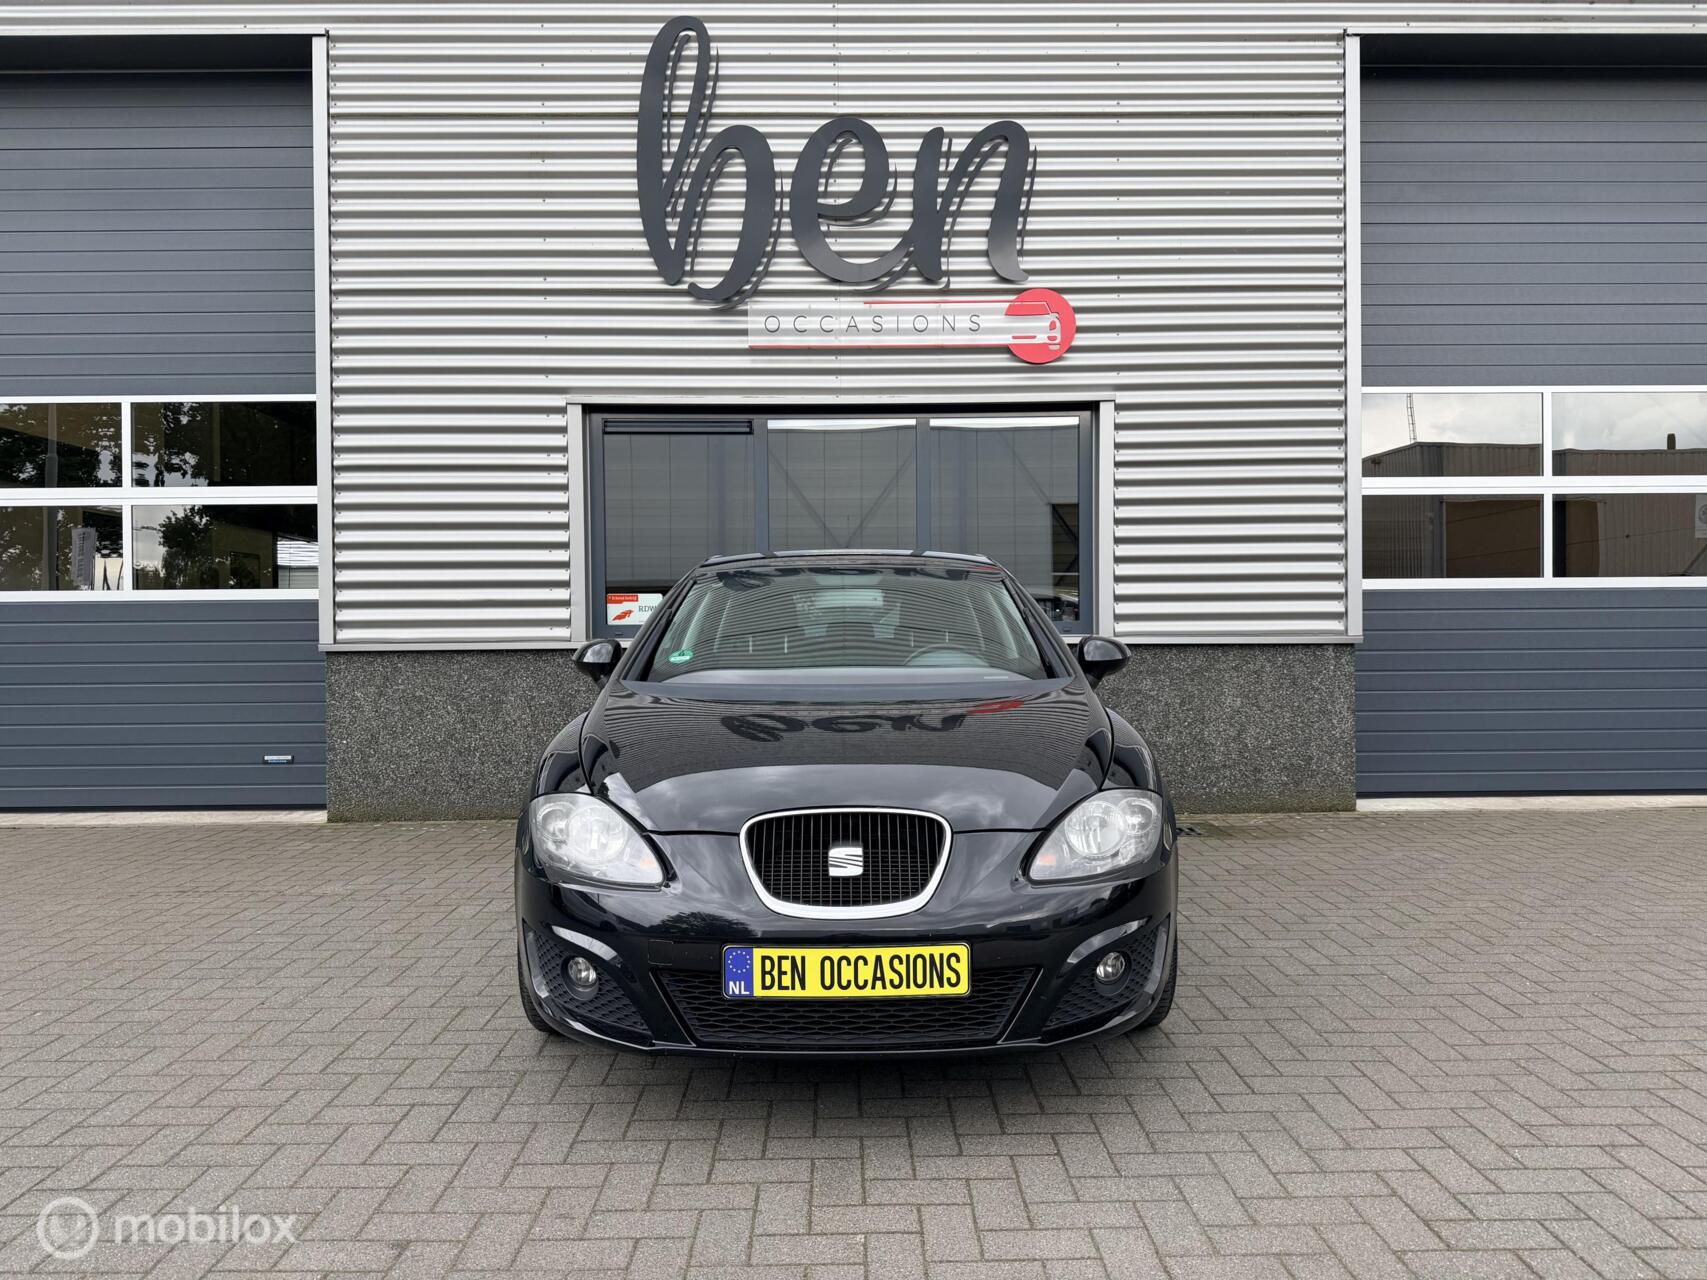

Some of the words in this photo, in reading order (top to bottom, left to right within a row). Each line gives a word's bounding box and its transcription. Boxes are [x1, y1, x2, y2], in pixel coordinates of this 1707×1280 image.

[637, 15, 1030, 302] ben
[763, 313, 982, 334] OCCASIONS
[760, 955, 806, 991] BEN
[820, 952, 961, 991] OCCASIONS
[728, 980, 750, 995] NL
